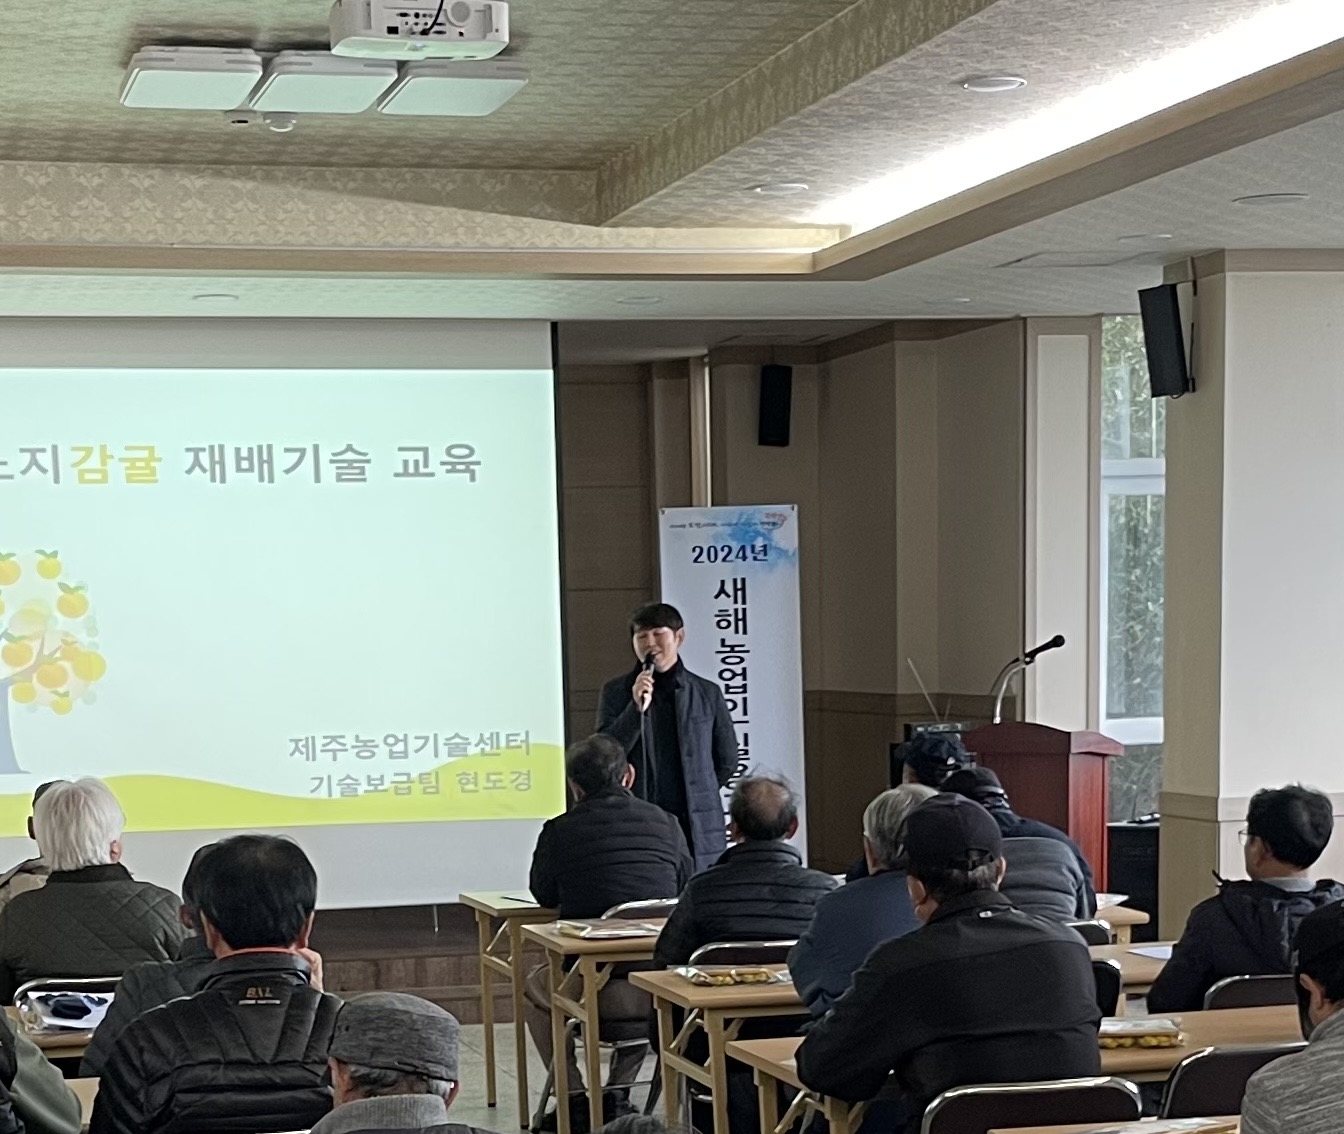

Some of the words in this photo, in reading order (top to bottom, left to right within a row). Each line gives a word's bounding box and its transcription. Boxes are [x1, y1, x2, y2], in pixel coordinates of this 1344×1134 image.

[184, 443, 372, 485] 재배기술
[393, 443, 483, 484] 교육
[691, 543, 769, 564] 2024년
[288, 730, 532, 762] 제주농업기술센터
[309, 771, 441, 798] 기술보급팀
[455, 769, 533, 794] 현도경
